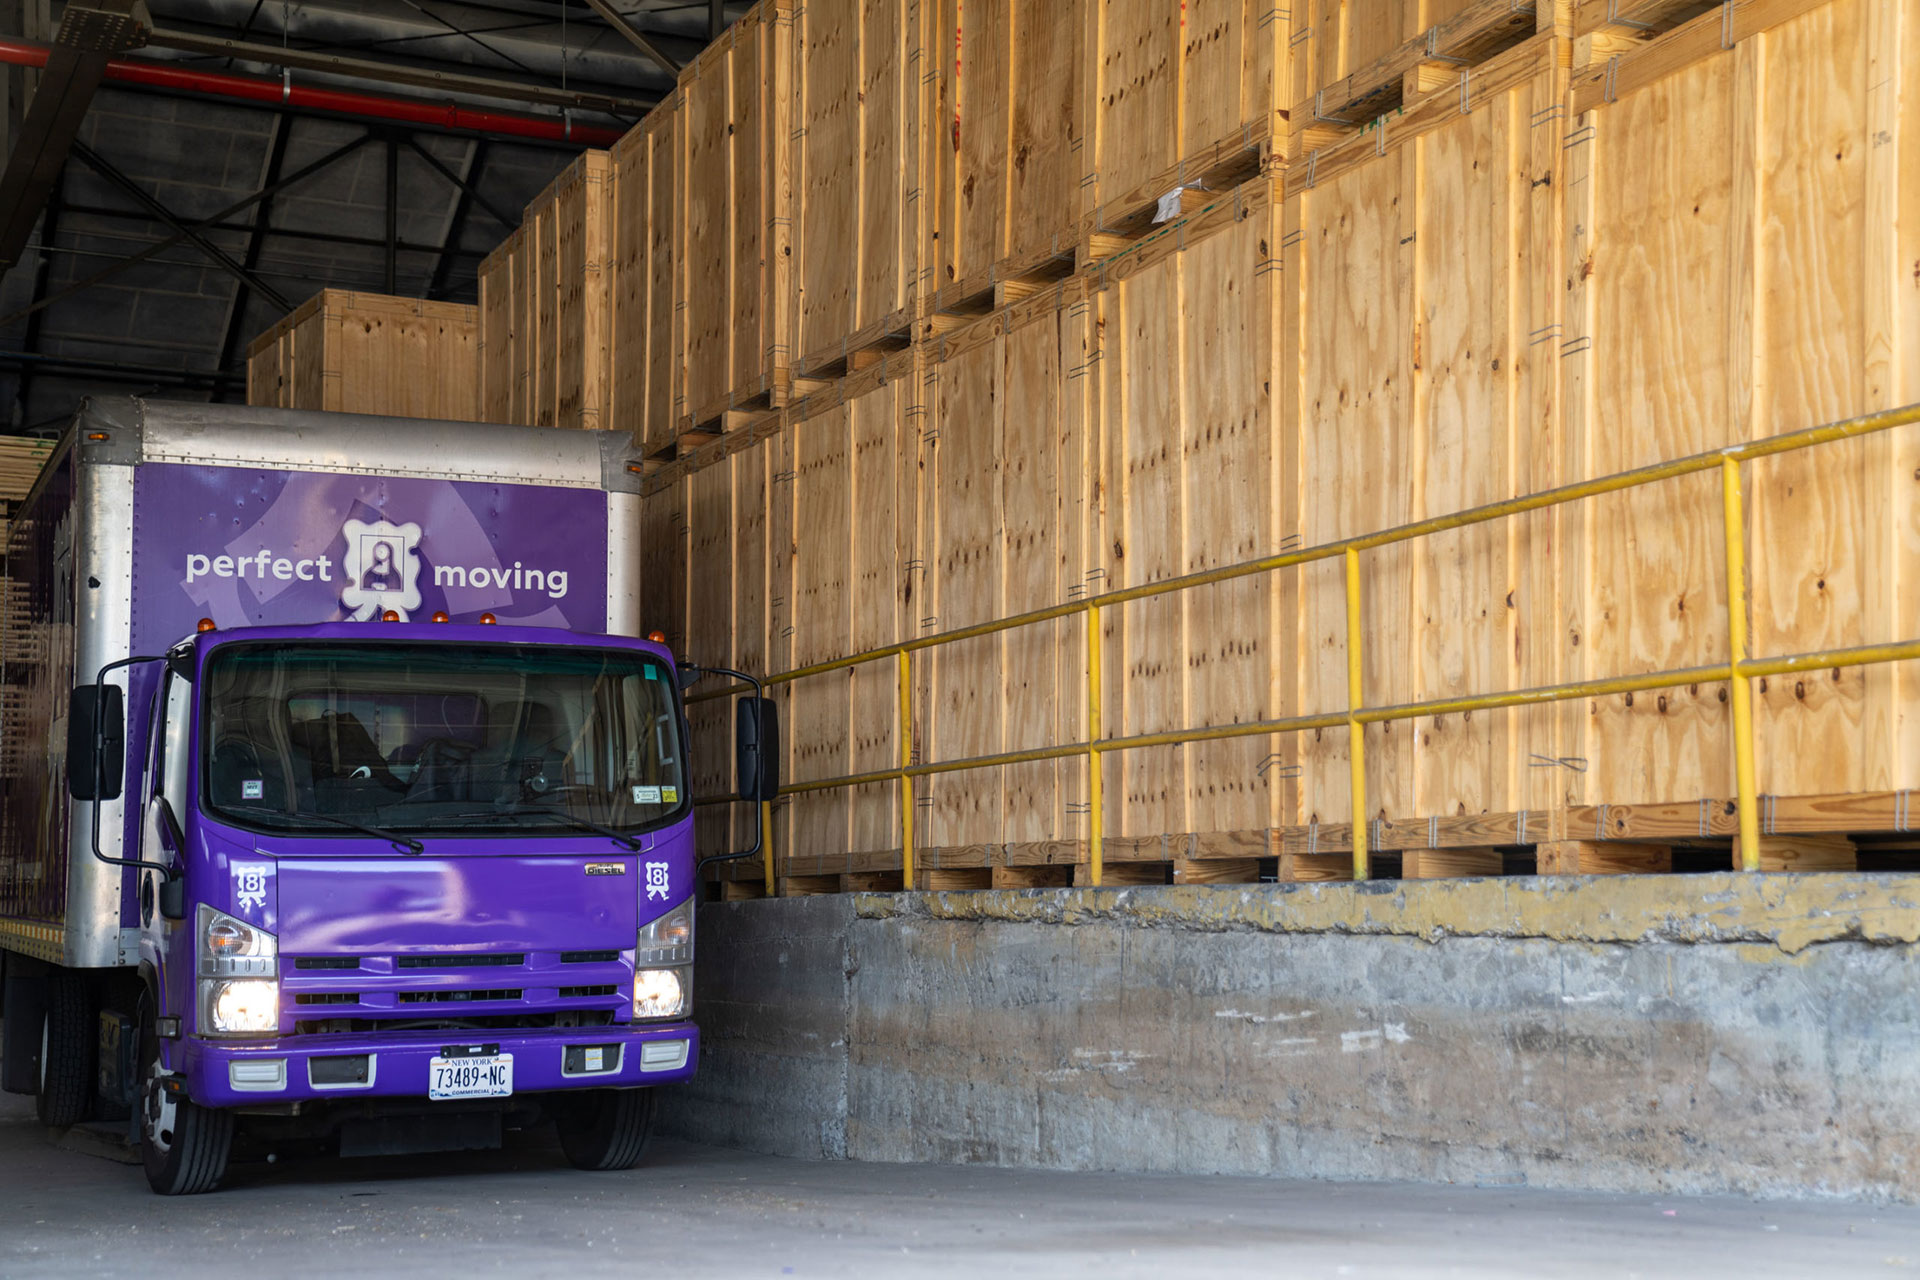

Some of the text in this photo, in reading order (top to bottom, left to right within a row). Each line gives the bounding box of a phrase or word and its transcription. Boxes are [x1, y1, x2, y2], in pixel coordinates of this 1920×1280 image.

[186, 549, 332, 583] perfect
[434, 561, 568, 599] moving
[246, 874, 258, 891] 8
[653, 869, 663, 884] 8
[452, 1058, 492, 1067] NEW YORK
